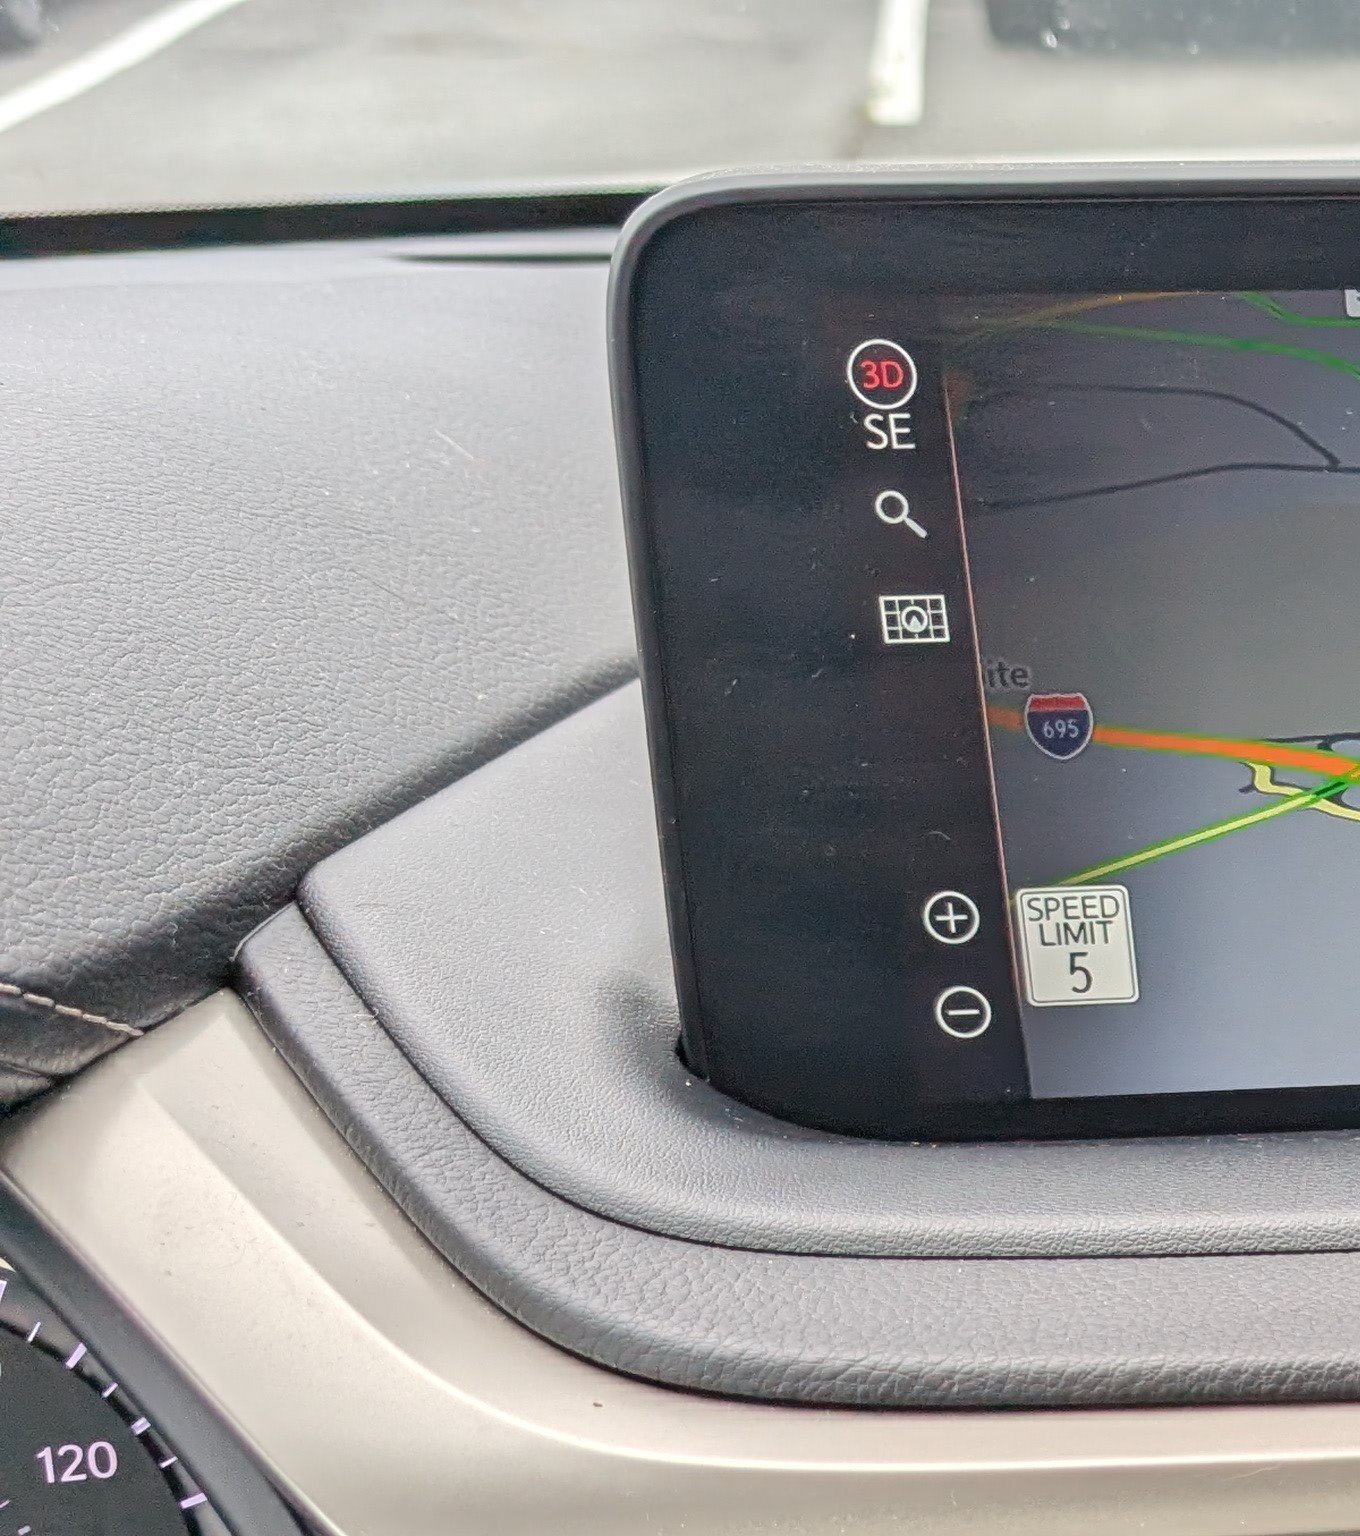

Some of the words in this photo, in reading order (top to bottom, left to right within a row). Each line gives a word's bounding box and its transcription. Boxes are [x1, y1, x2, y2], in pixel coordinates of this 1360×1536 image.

[860, 361, 905, 389] 3D
[864, 412, 917, 451] SE
[1043, 718, 1080, 739] 695
[1026, 894, 1121, 922] SPEED
[1038, 920, 1114, 947] LIMIT
[1069, 951, 1094, 994] 5
[36, 1440, 118, 1484] 120
